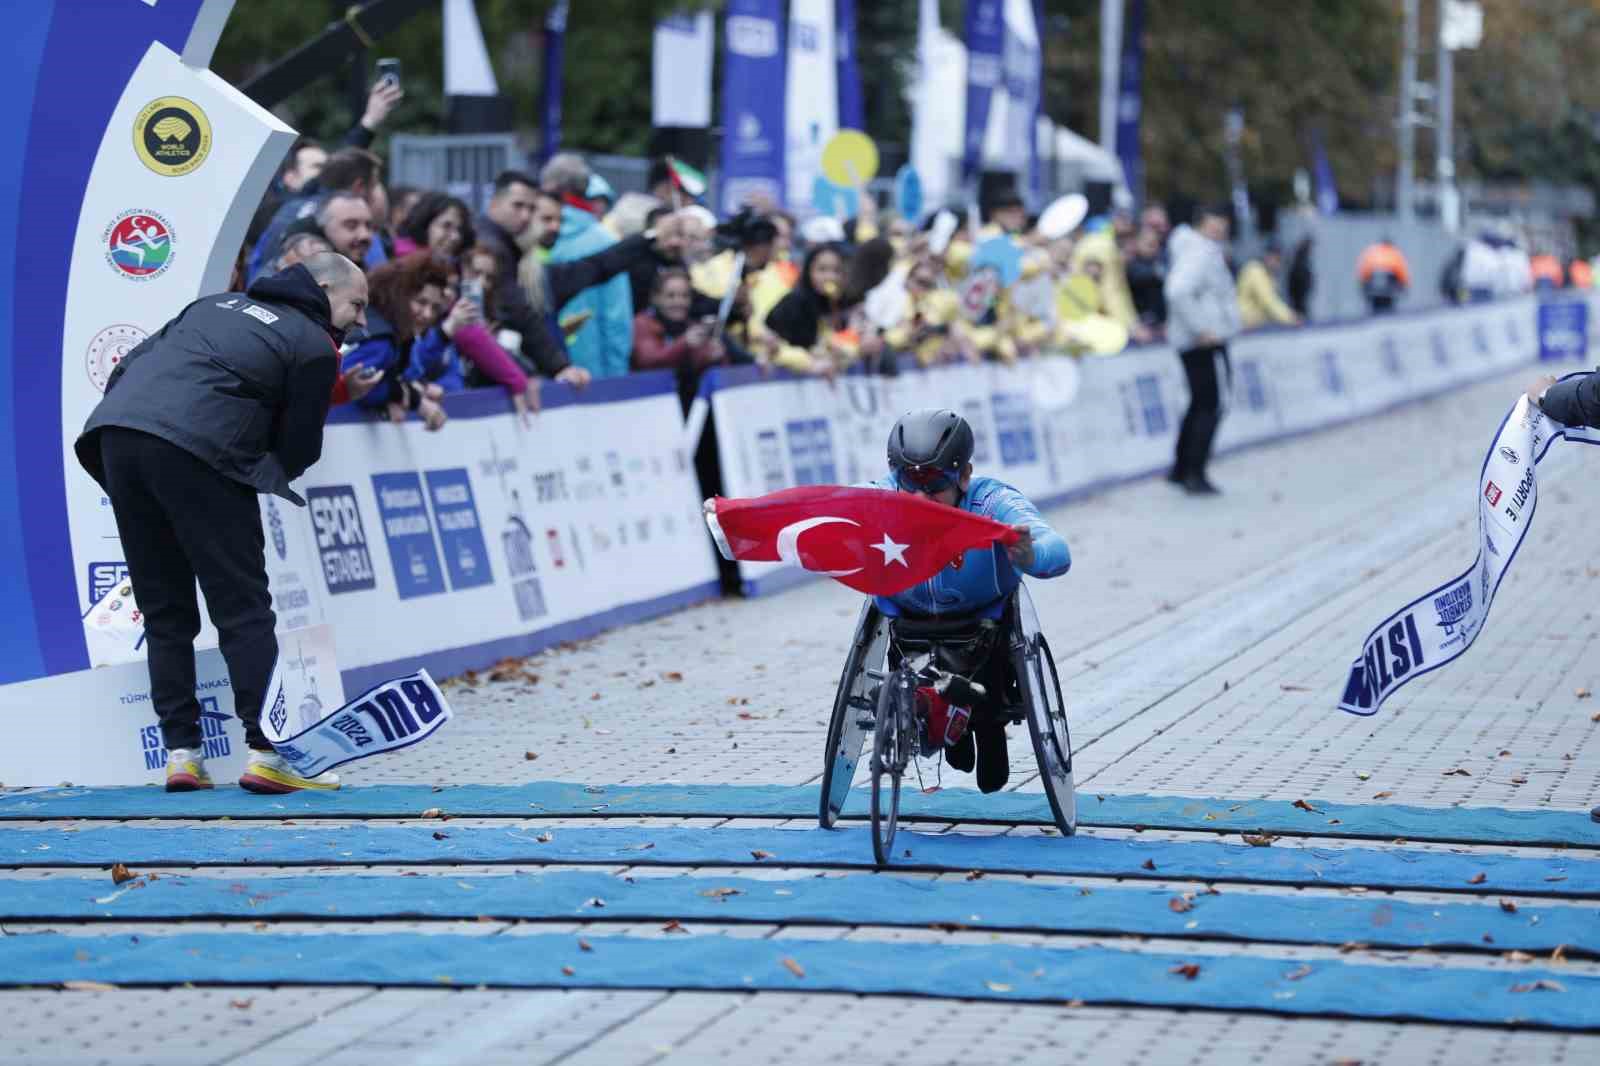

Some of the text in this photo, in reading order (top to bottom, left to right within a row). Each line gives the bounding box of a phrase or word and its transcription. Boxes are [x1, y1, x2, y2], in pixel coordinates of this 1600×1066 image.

[310, 495, 364, 548] SPOR
[331, 715, 373, 748] 2024
[352, 679, 443, 742] BUL
